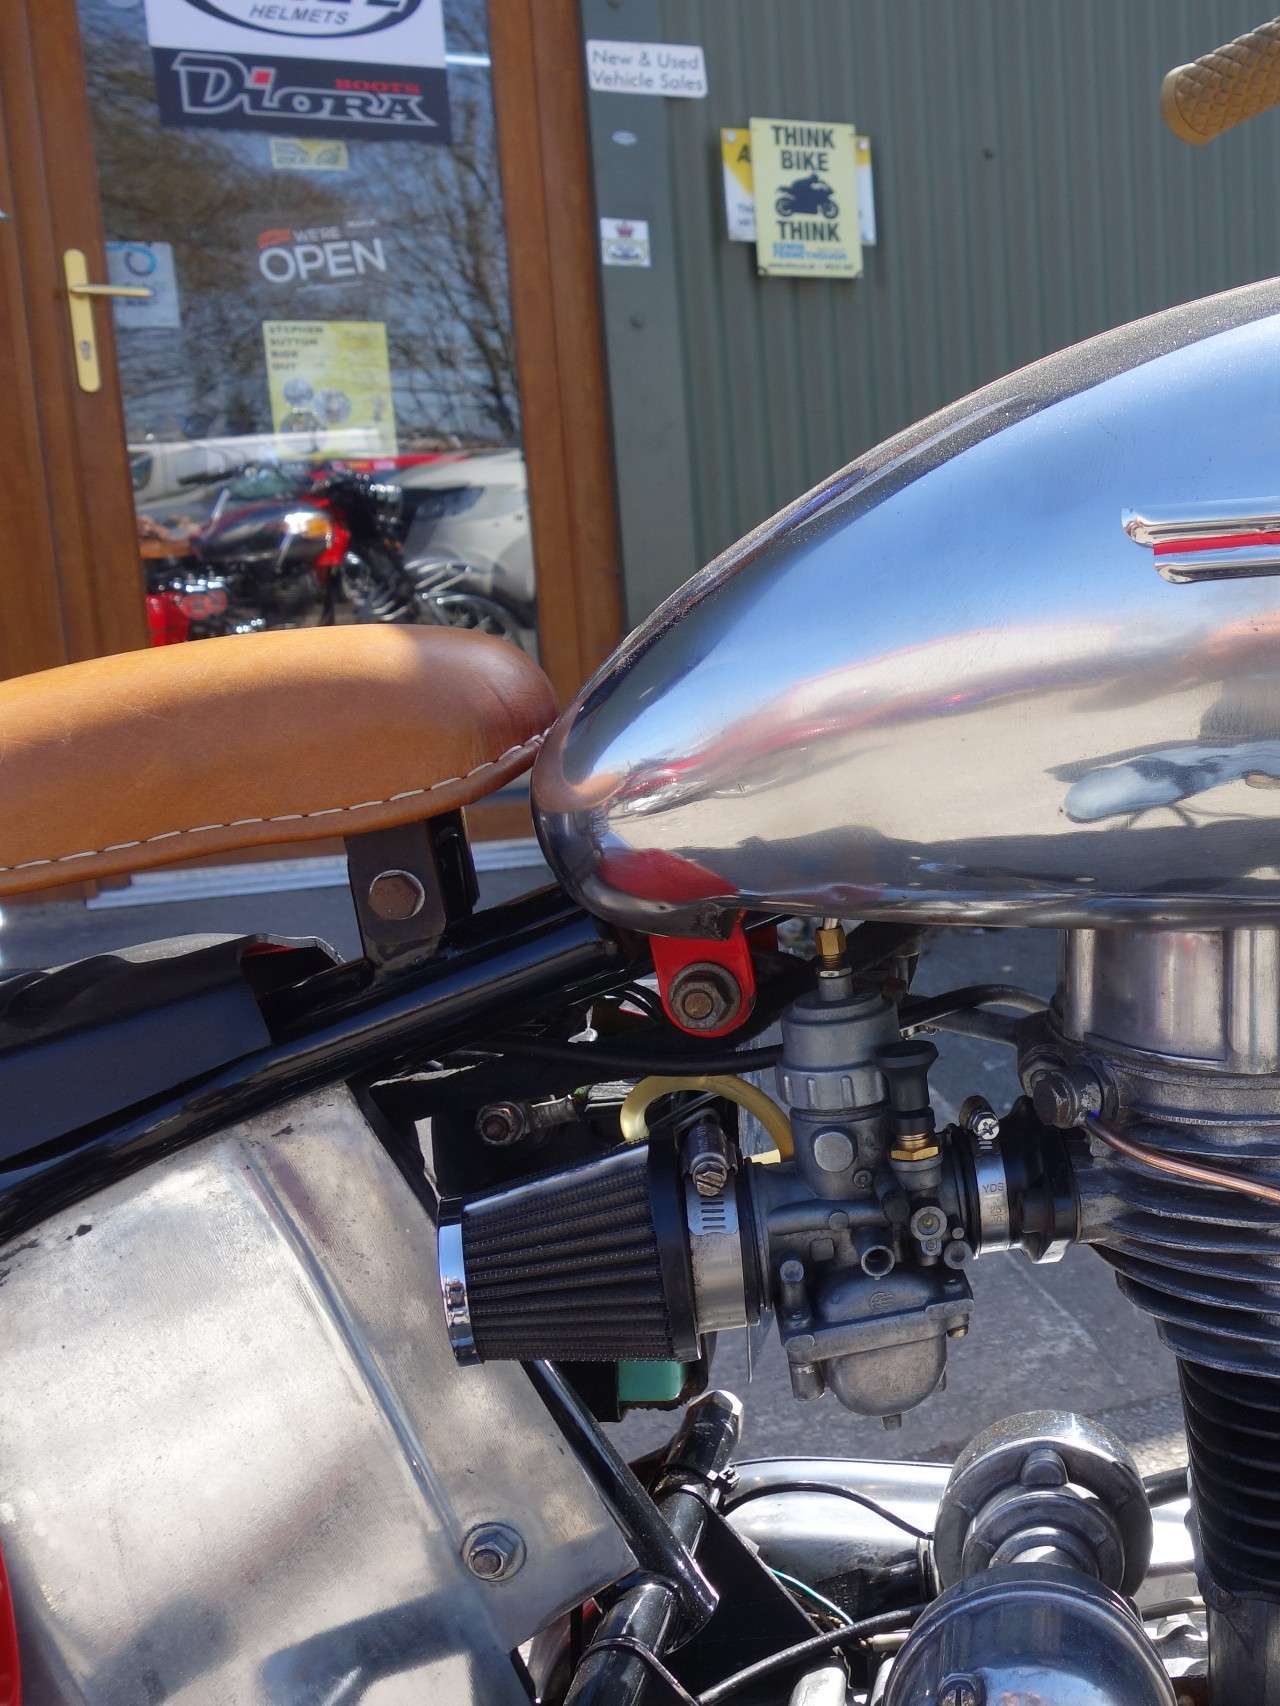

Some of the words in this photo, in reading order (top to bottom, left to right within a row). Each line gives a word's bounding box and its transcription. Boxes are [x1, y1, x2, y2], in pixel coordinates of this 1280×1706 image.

[250, 5, 349, 25] HELMETS
[592, 49, 632, 65] New
[639, 51, 651, 67] &
[657, 52, 698, 70] Used
[592, 68, 654, 87] Vehicle
[661, 72, 704, 91] Sales
[771, 126, 835, 148] THINK
[781, 149, 829, 172] BIKE
[777, 220, 840, 241] THINK
[259, 237, 387, 283] OPEN
